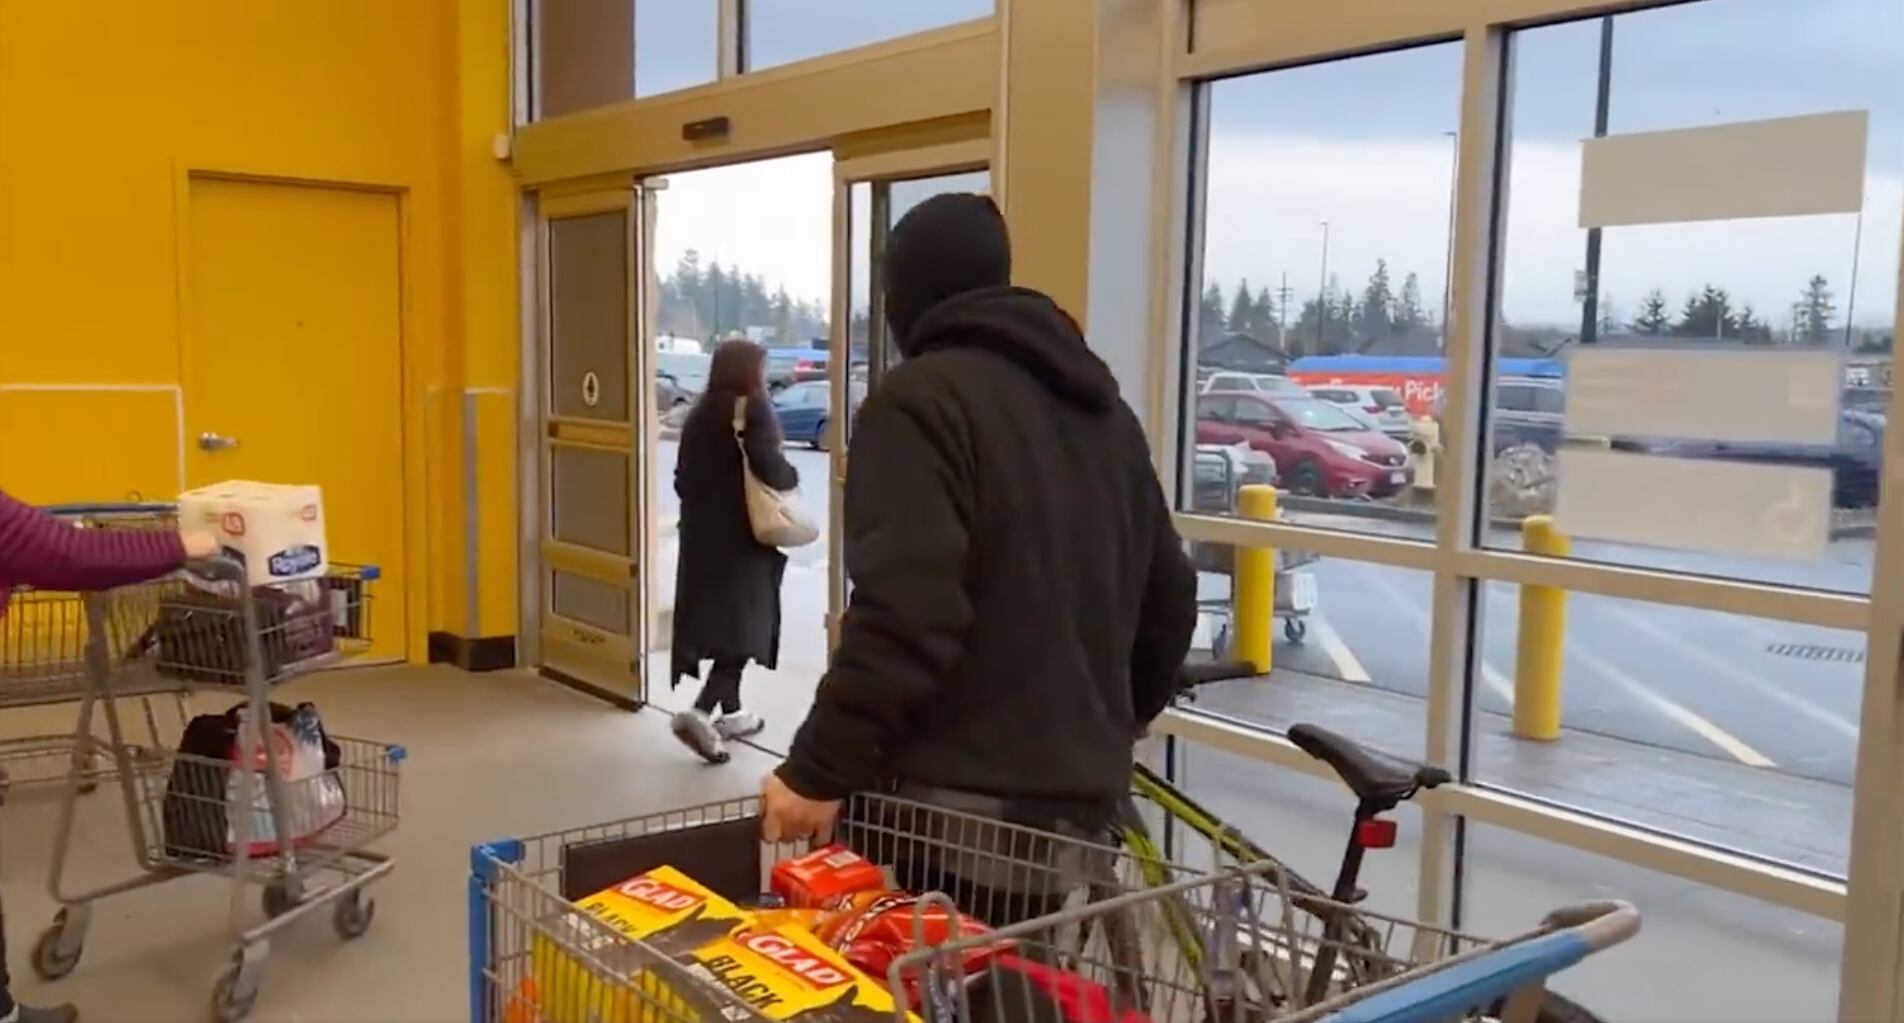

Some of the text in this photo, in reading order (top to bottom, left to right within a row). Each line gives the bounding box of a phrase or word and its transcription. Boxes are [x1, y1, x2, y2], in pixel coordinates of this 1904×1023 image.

[620, 879, 695, 910] GLAD
[701, 954, 784, 1010] BLACK
[747, 934, 847, 984] GLAD
